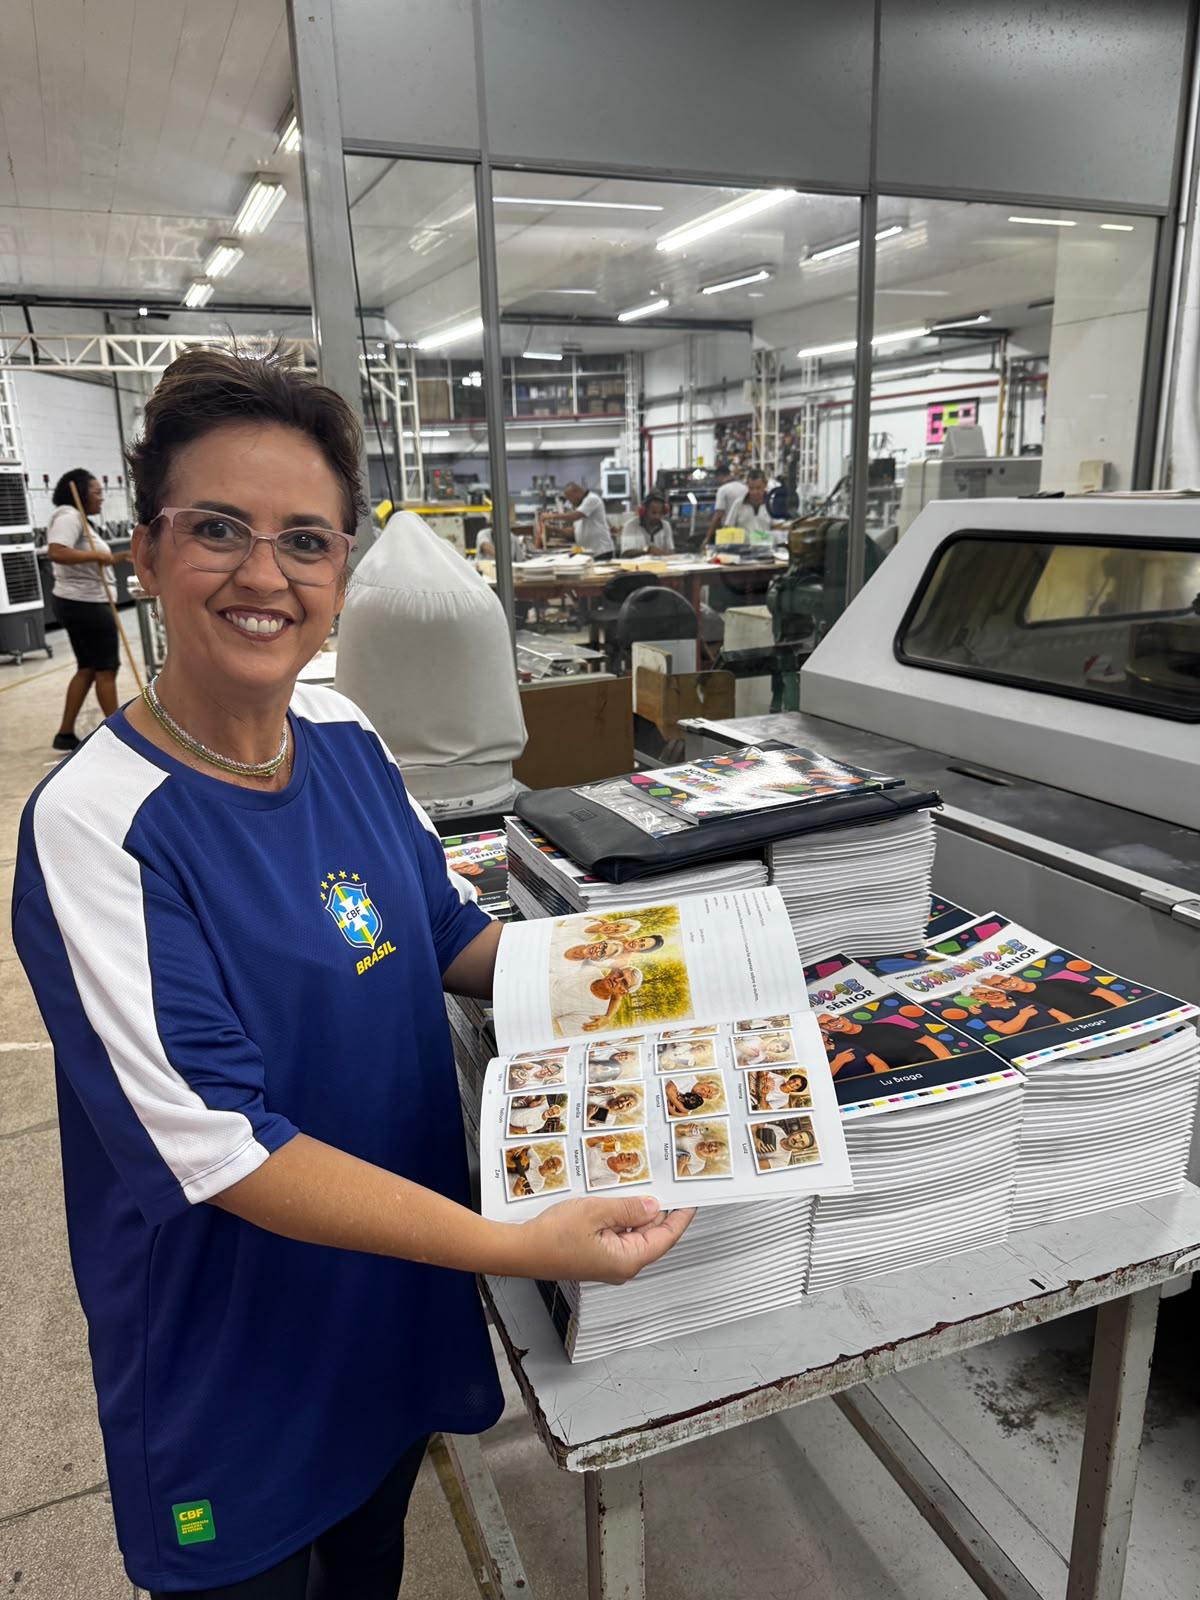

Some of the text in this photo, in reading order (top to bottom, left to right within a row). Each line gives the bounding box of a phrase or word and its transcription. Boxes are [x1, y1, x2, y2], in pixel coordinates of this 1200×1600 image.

[345, 906, 362, 921] CBF
[355, 940, 397, 976] BRASIL
[994, 947, 1039, 973] SÊNIOR
[825, 988, 876, 1012] SÊNIOR
[1078, 1019, 1107, 1029] Braga
[879, 1071, 923, 1087] Lu Braga
[179, 1507, 204, 1521] CBF
